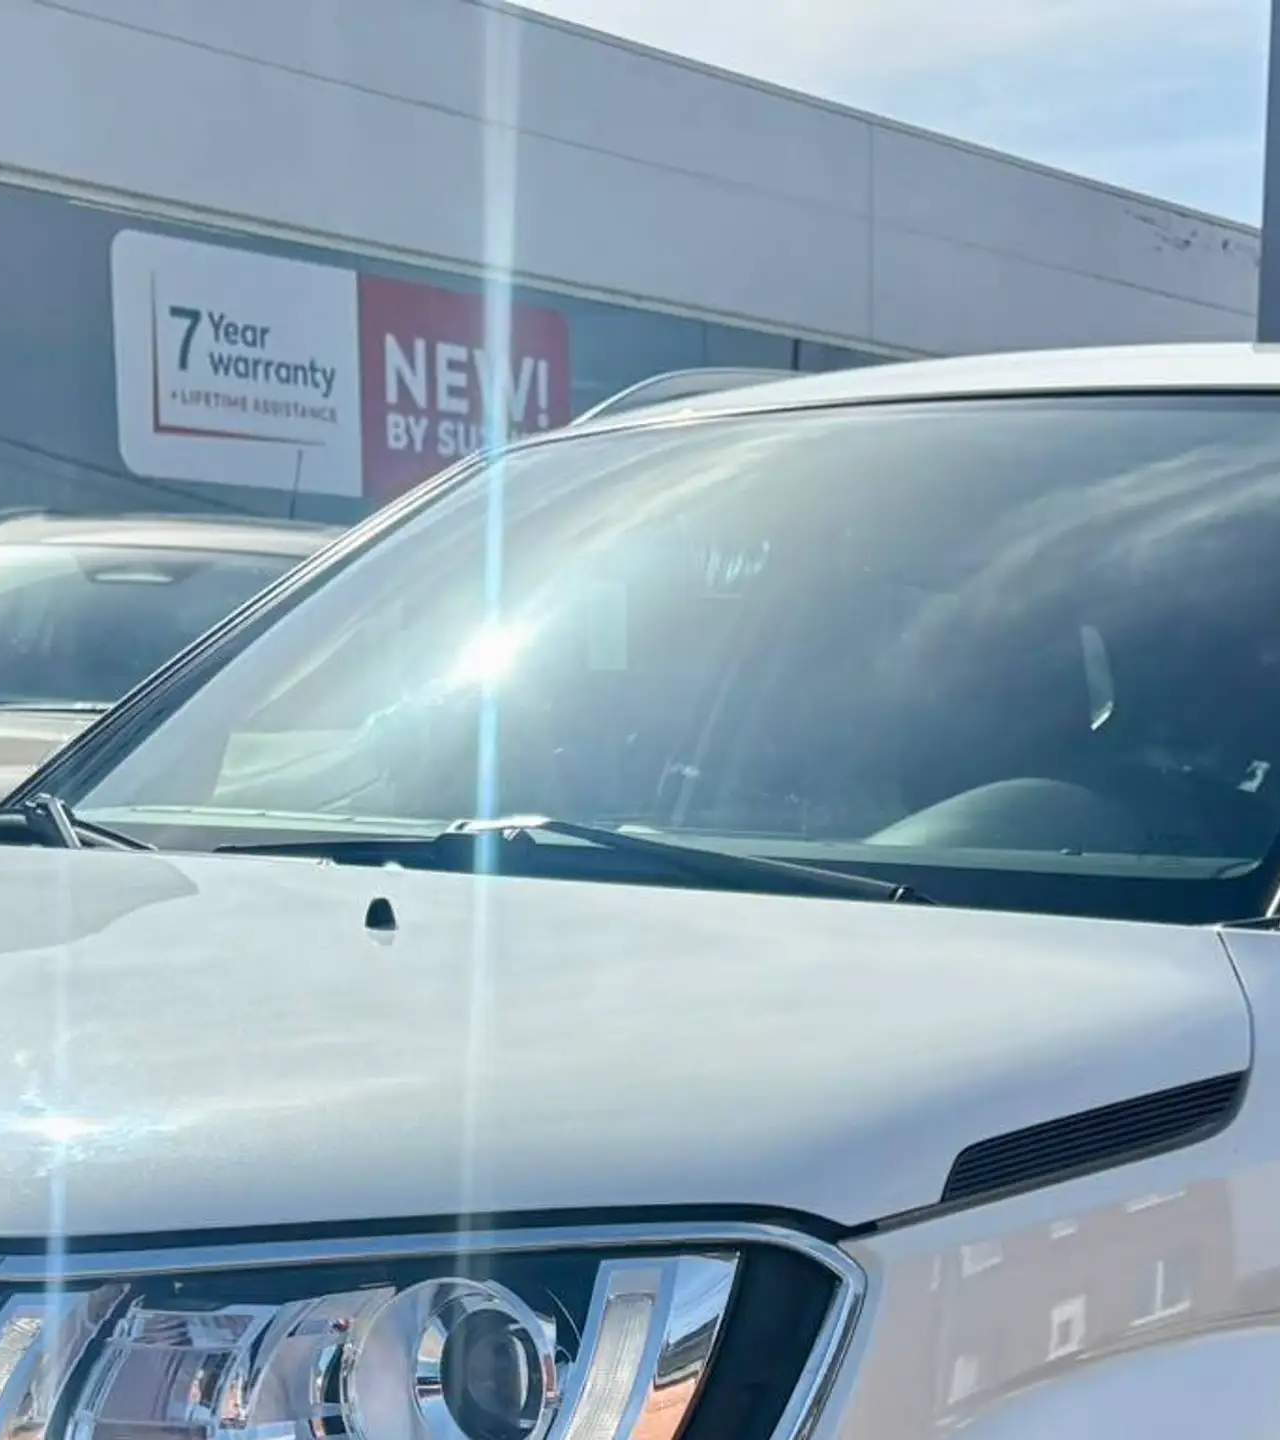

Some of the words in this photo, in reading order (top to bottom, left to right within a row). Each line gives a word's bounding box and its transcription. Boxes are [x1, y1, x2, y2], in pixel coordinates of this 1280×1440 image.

[168, 305, 202, 371] 7
[207, 310, 270, 349] Year
[207, 350, 336, 399] warranty
[384, 331, 549, 430] NEW!
[386, 411, 429, 453] BY
